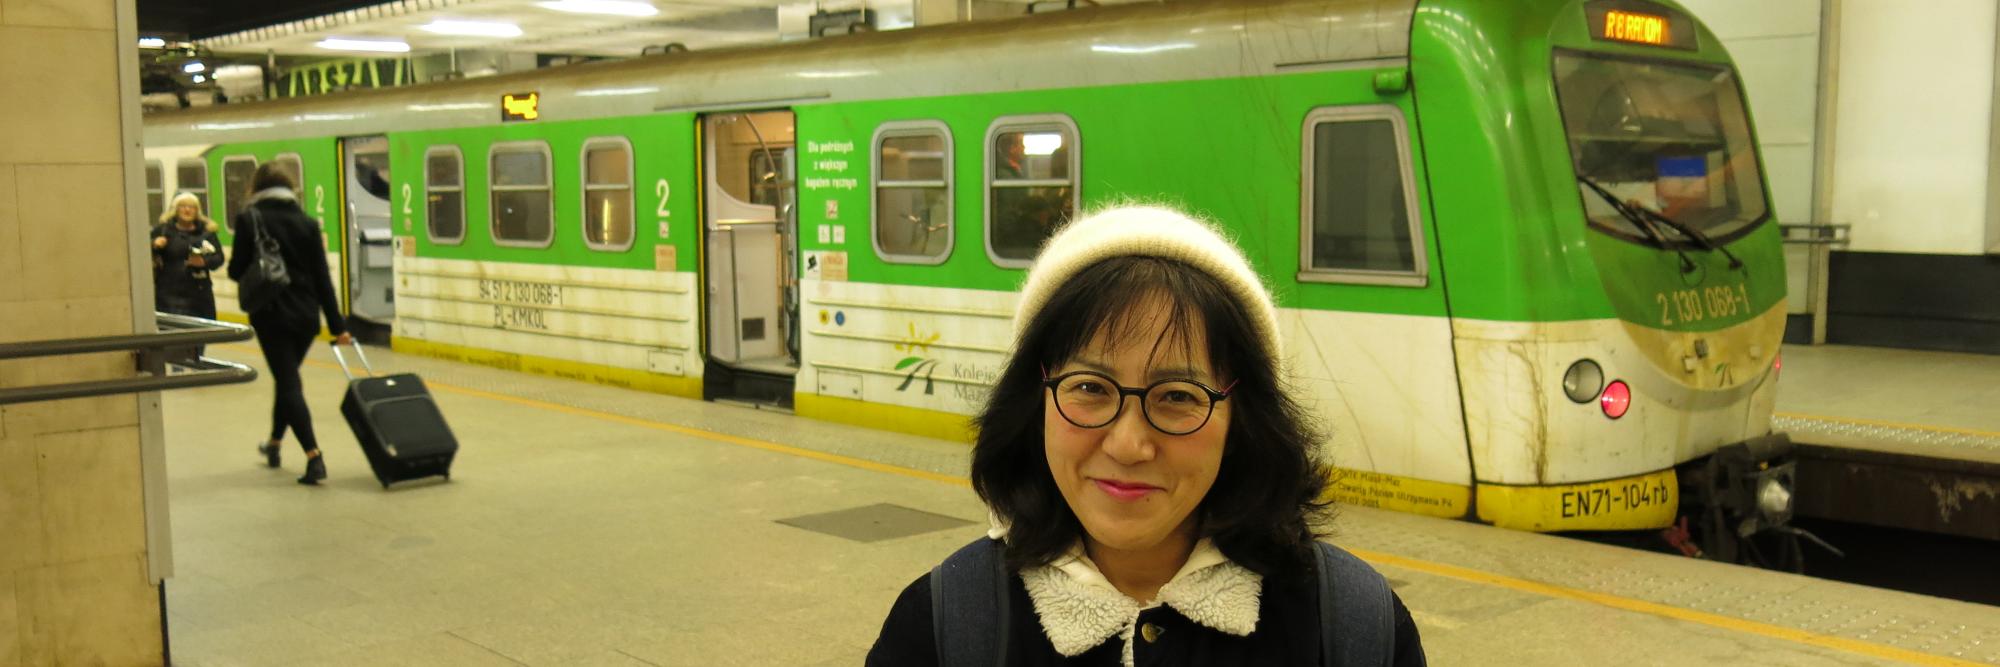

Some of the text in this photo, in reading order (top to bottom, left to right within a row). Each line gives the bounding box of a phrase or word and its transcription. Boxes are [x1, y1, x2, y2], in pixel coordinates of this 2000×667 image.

[1604, 11, 1615, 38] R
[315, 185, 325, 213] 2
[402, 183, 412, 214] 2
[656, 179, 671, 217] 2
[505, 281, 512, 302] 2
[514, 281, 531, 303] 130
[533, 283, 563, 306] 068-1
[1656, 282, 1751, 326] 2 130 068-1
[494, 304, 548, 330] PL-KMKOL
